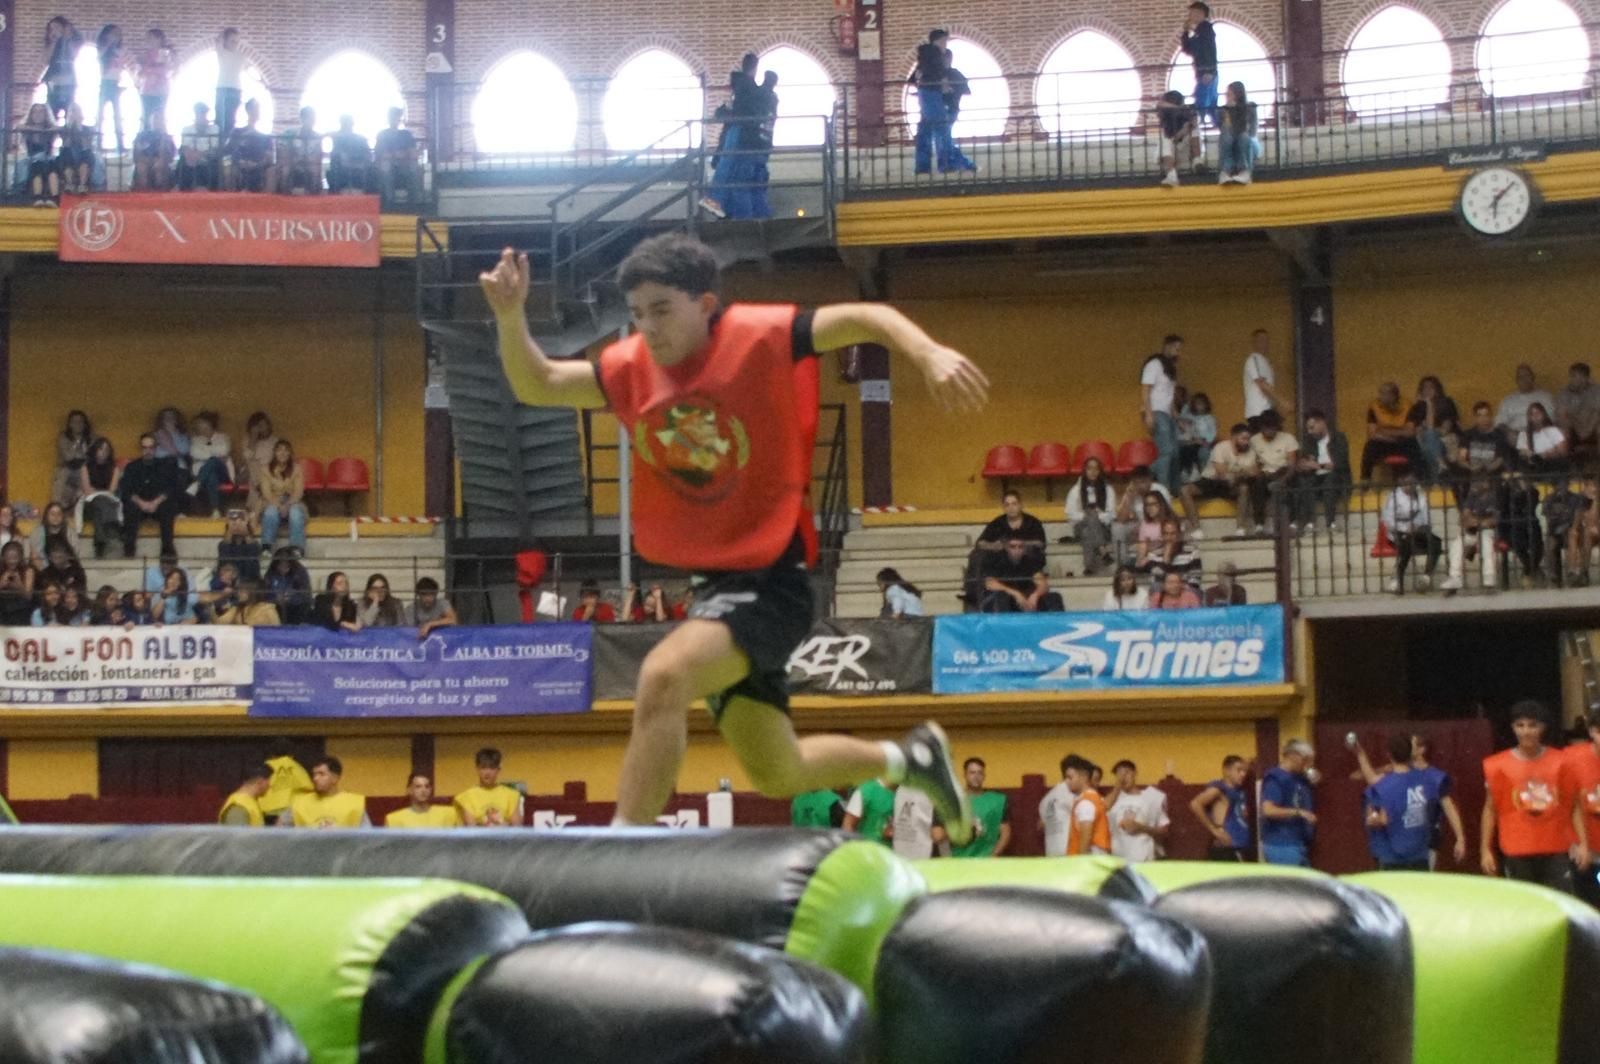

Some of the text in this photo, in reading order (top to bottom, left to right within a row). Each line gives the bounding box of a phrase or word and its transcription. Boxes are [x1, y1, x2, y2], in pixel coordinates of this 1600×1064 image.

[863, 10, 878, 29] 2
[433, 24, 447, 43] 3
[153, 209, 188, 244] X
[205, 218, 374, 242] ANIVERSARIO
[1309, 305, 1324, 326] 4
[1155, 619, 1264, 640] Autoescuela
[4, 637, 58, 663] CAL
[144, 636, 217, 660] ALBA
[254, 643, 574, 661] ASESORÍA ENERGÉTICA ALBA DE TORMES
[1105, 630, 1266, 680] Tormes
[5, 663, 217, 683] calefacción fontanería gas
[333, 676, 509, 692] Soluciones para tu ahorro
[345, 692, 414, 708] energético
[417, 692, 434, 705] de
[437, 692, 459, 705] luz
[474, 693, 498, 707] gas
